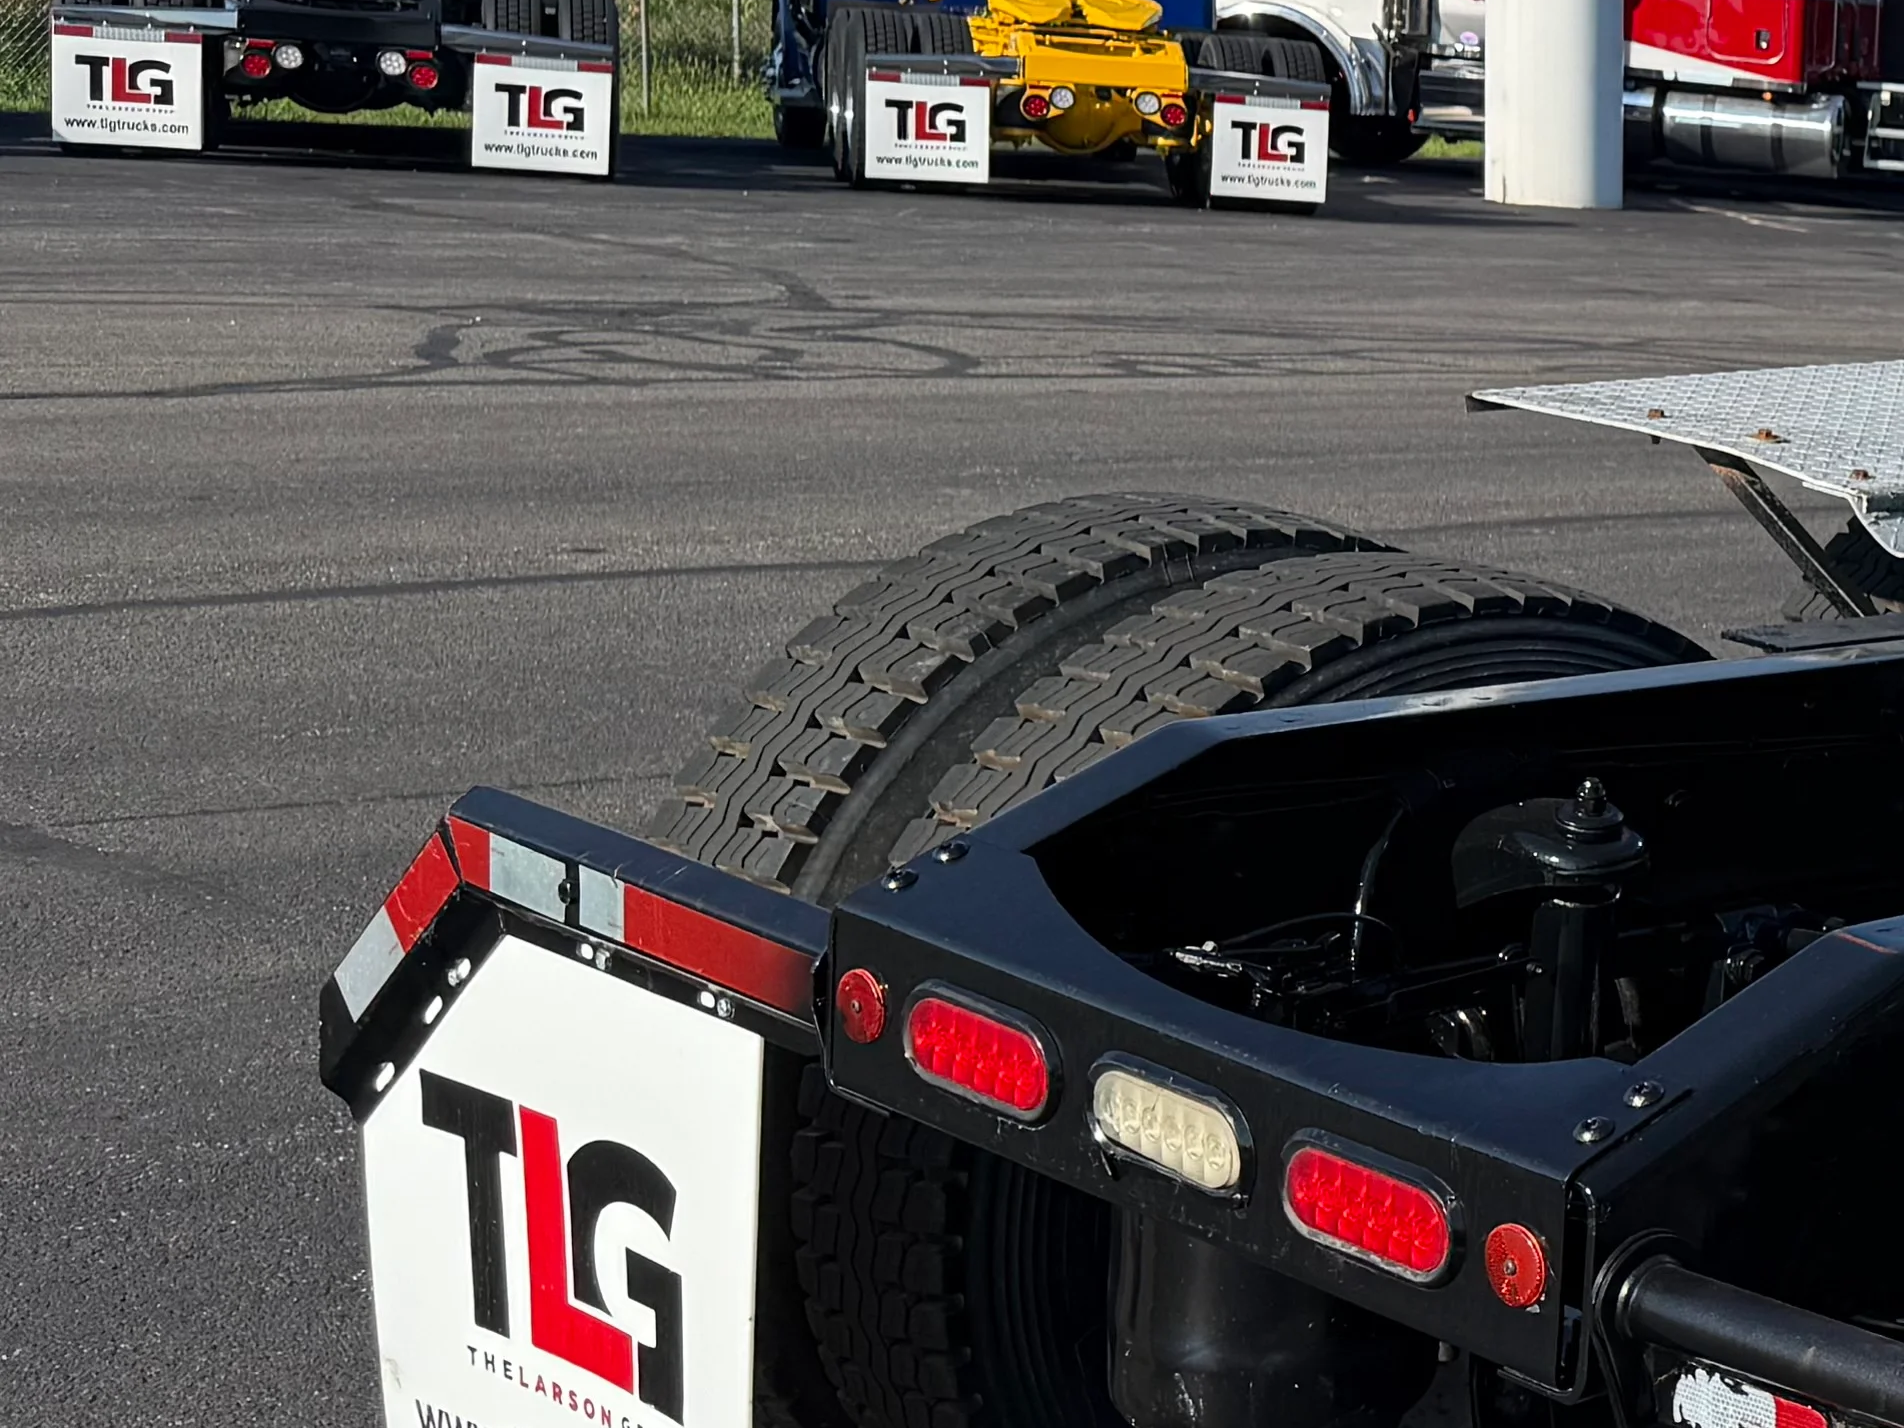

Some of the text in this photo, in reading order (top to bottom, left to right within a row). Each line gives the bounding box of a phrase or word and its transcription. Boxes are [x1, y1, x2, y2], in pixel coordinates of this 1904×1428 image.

[75, 54, 174, 106] TLG
[494, 83, 585, 132] TLG
[885, 98, 966, 143] TLG
[1231, 120, 1306, 164] TLG
[420, 1068, 685, 1426] TLG
